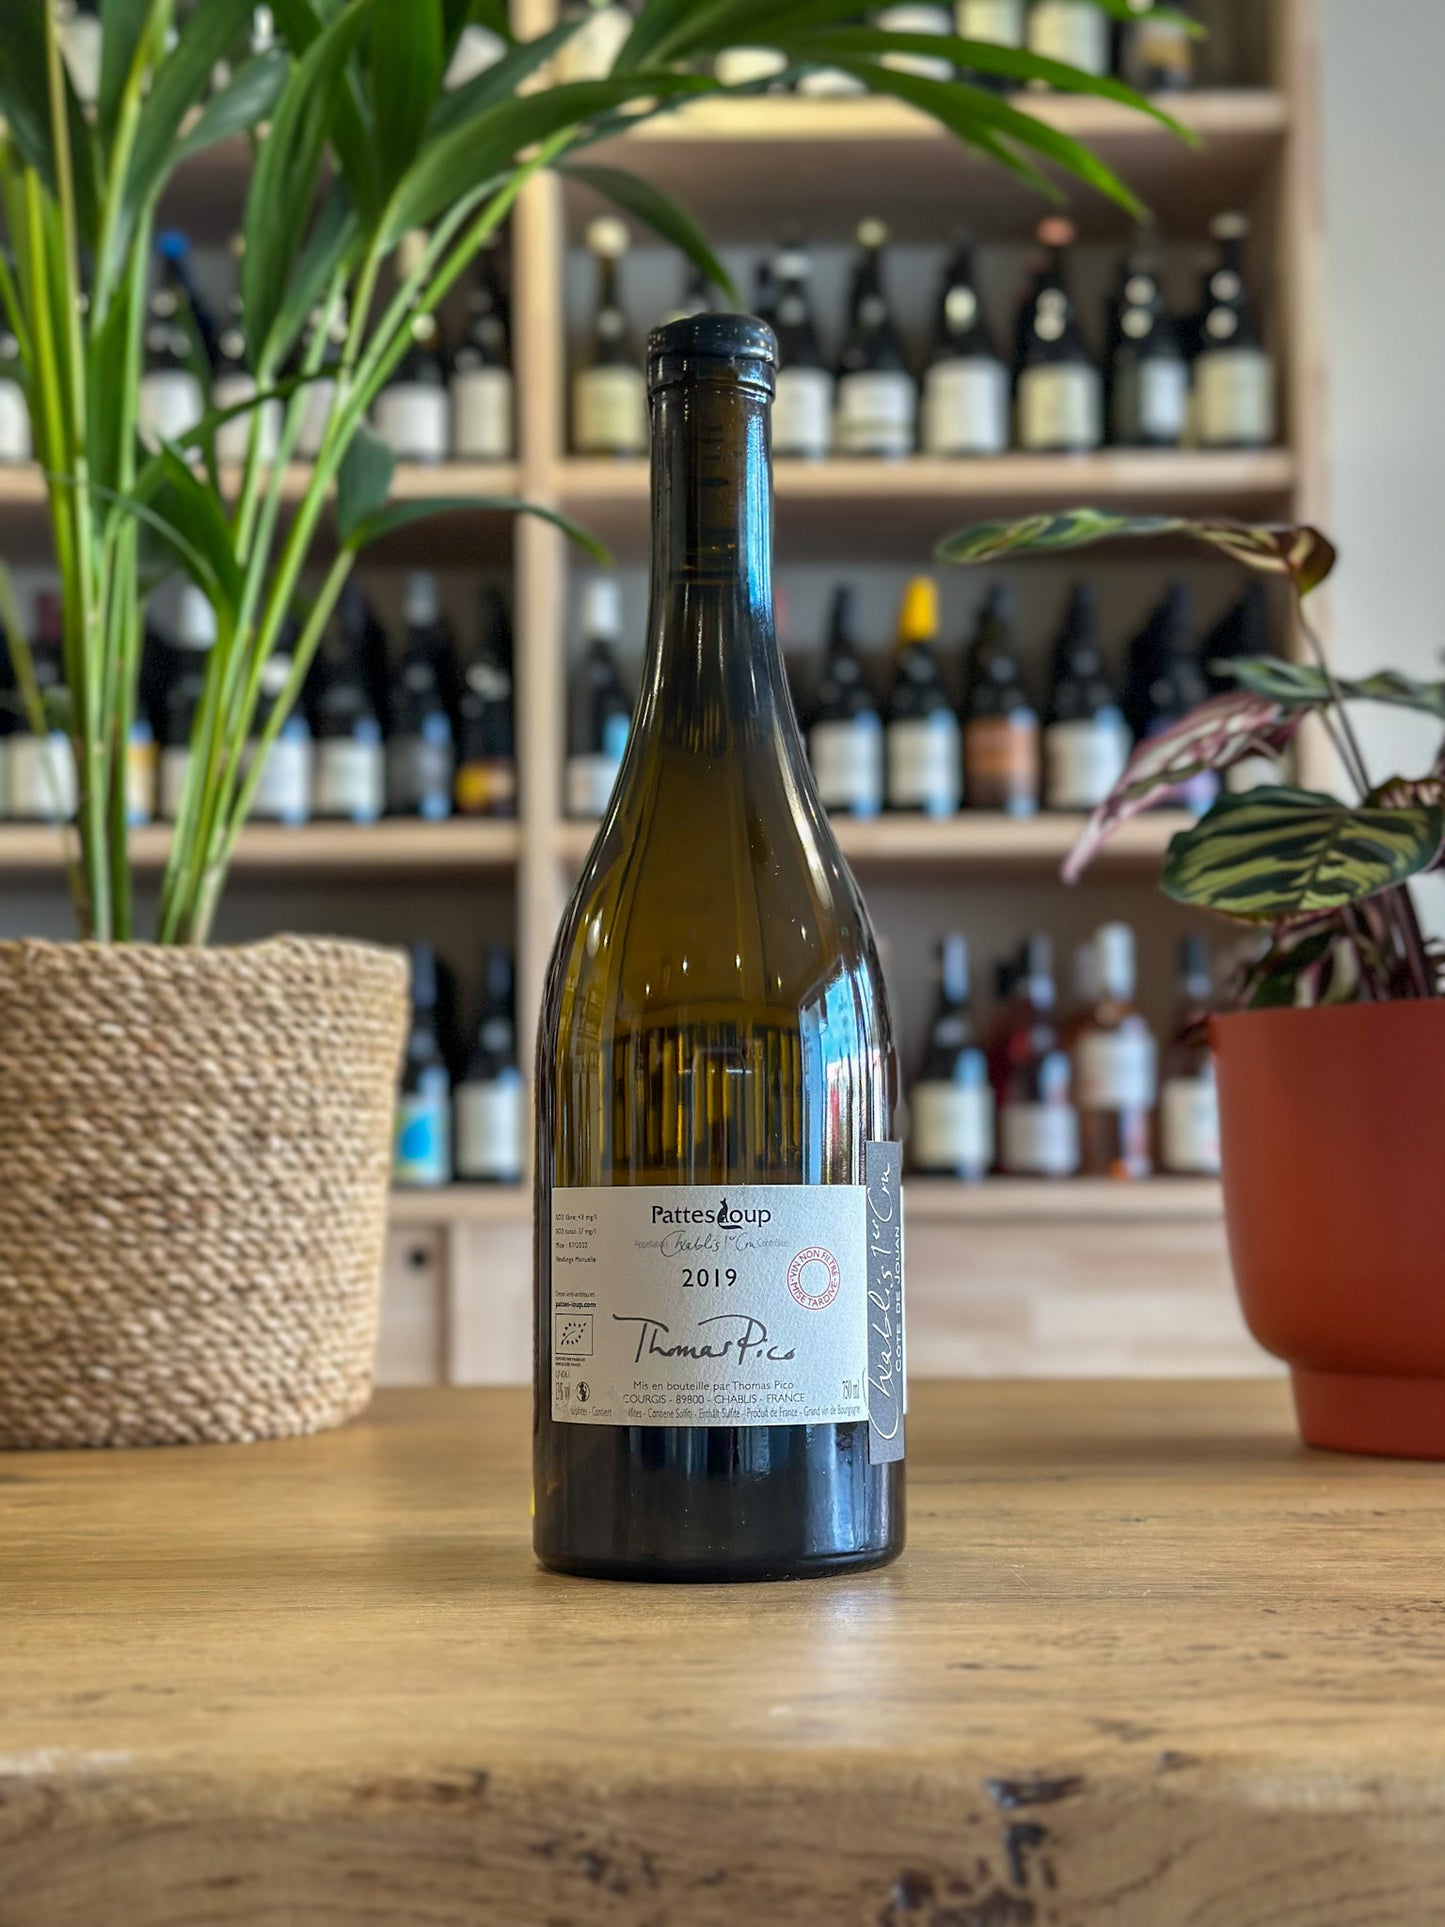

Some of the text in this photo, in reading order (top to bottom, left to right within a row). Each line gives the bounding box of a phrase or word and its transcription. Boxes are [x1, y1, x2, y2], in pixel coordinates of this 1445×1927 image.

[652, 1205, 715, 1224] Pattes
[660, 1230, 720, 1257] Chablis
[790, 1261, 801, 1278] VIN
[799, 1249, 820, 1263] NON
[682, 1268, 737, 1287] 2019
[791, 1281, 838, 1307] MISE TARDIVE
[612, 1313, 796, 1365] Thomas Pico
[633, 1379, 794, 1393] Mis en bouteille par Thomas Pico
[622, 1393, 806, 1405] COURGIS 89800 CHABLIS FRANCE
